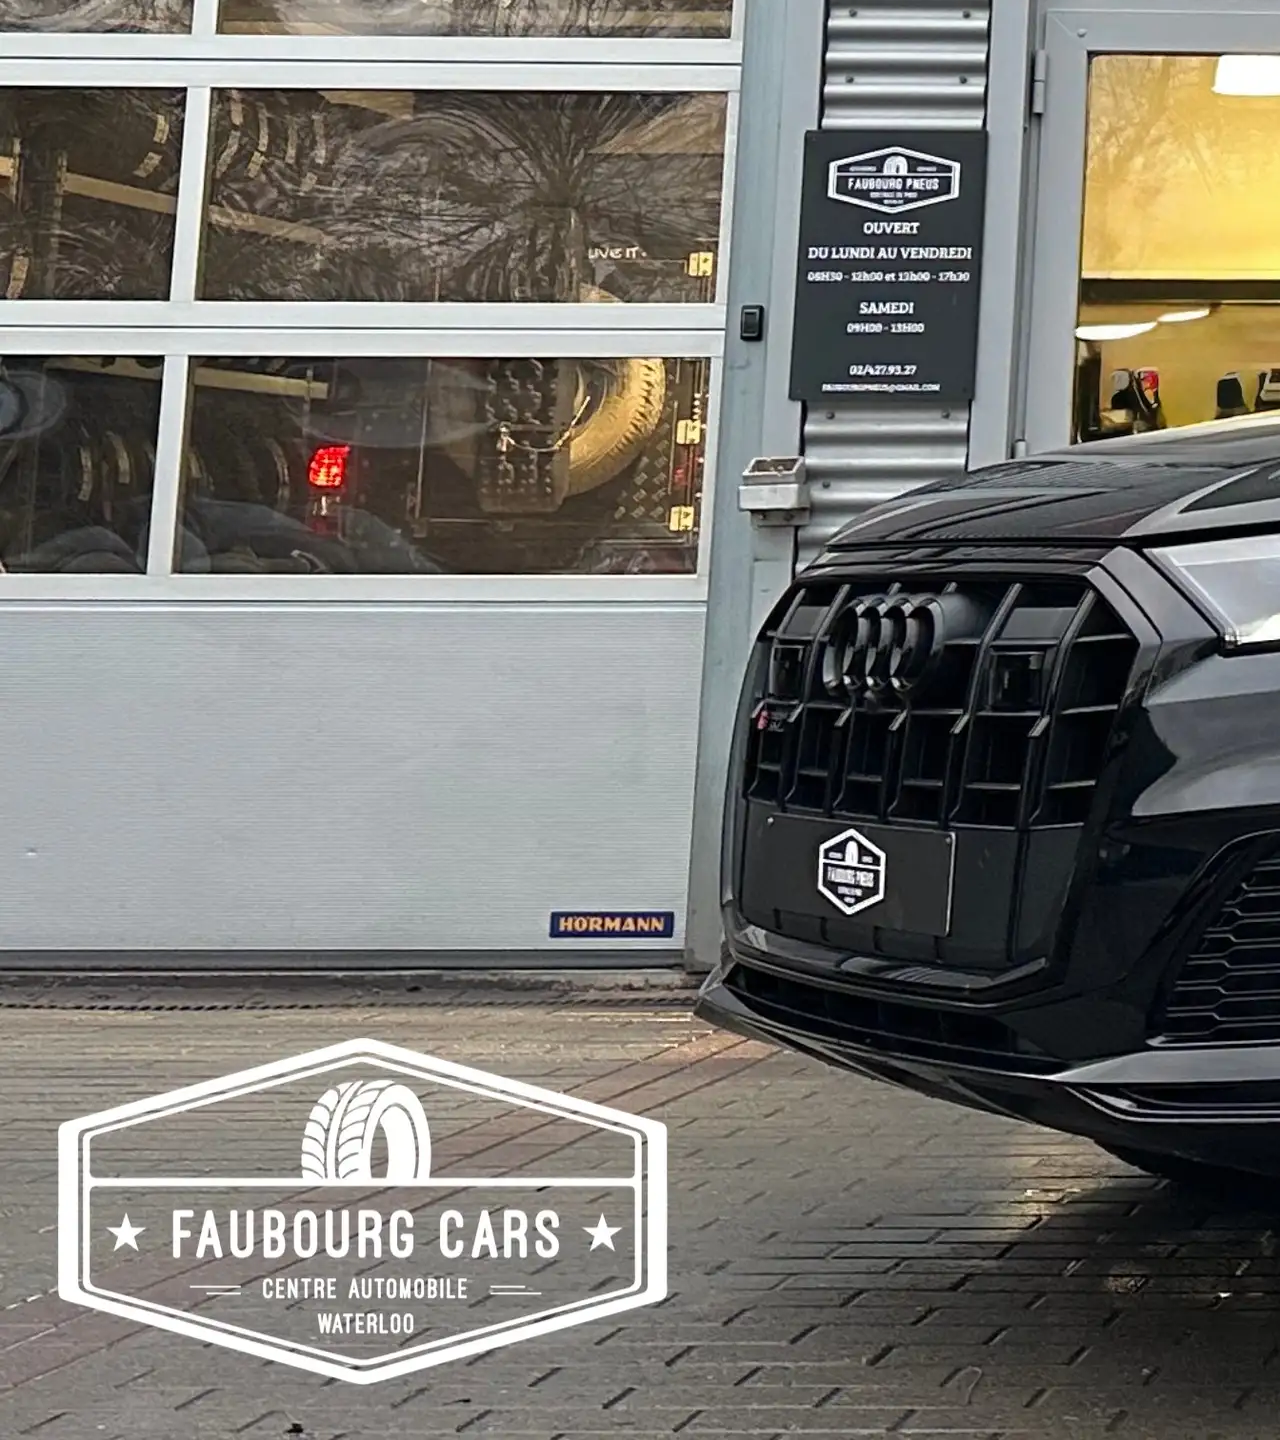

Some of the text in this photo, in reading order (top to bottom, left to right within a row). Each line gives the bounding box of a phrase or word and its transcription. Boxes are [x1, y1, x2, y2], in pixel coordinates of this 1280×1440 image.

[863, 222, 920, 235] OUVERT
[807, 247, 972, 260] DU LUNDI AU VENDREDI
[859, 302, 915, 315] SAMEDI
